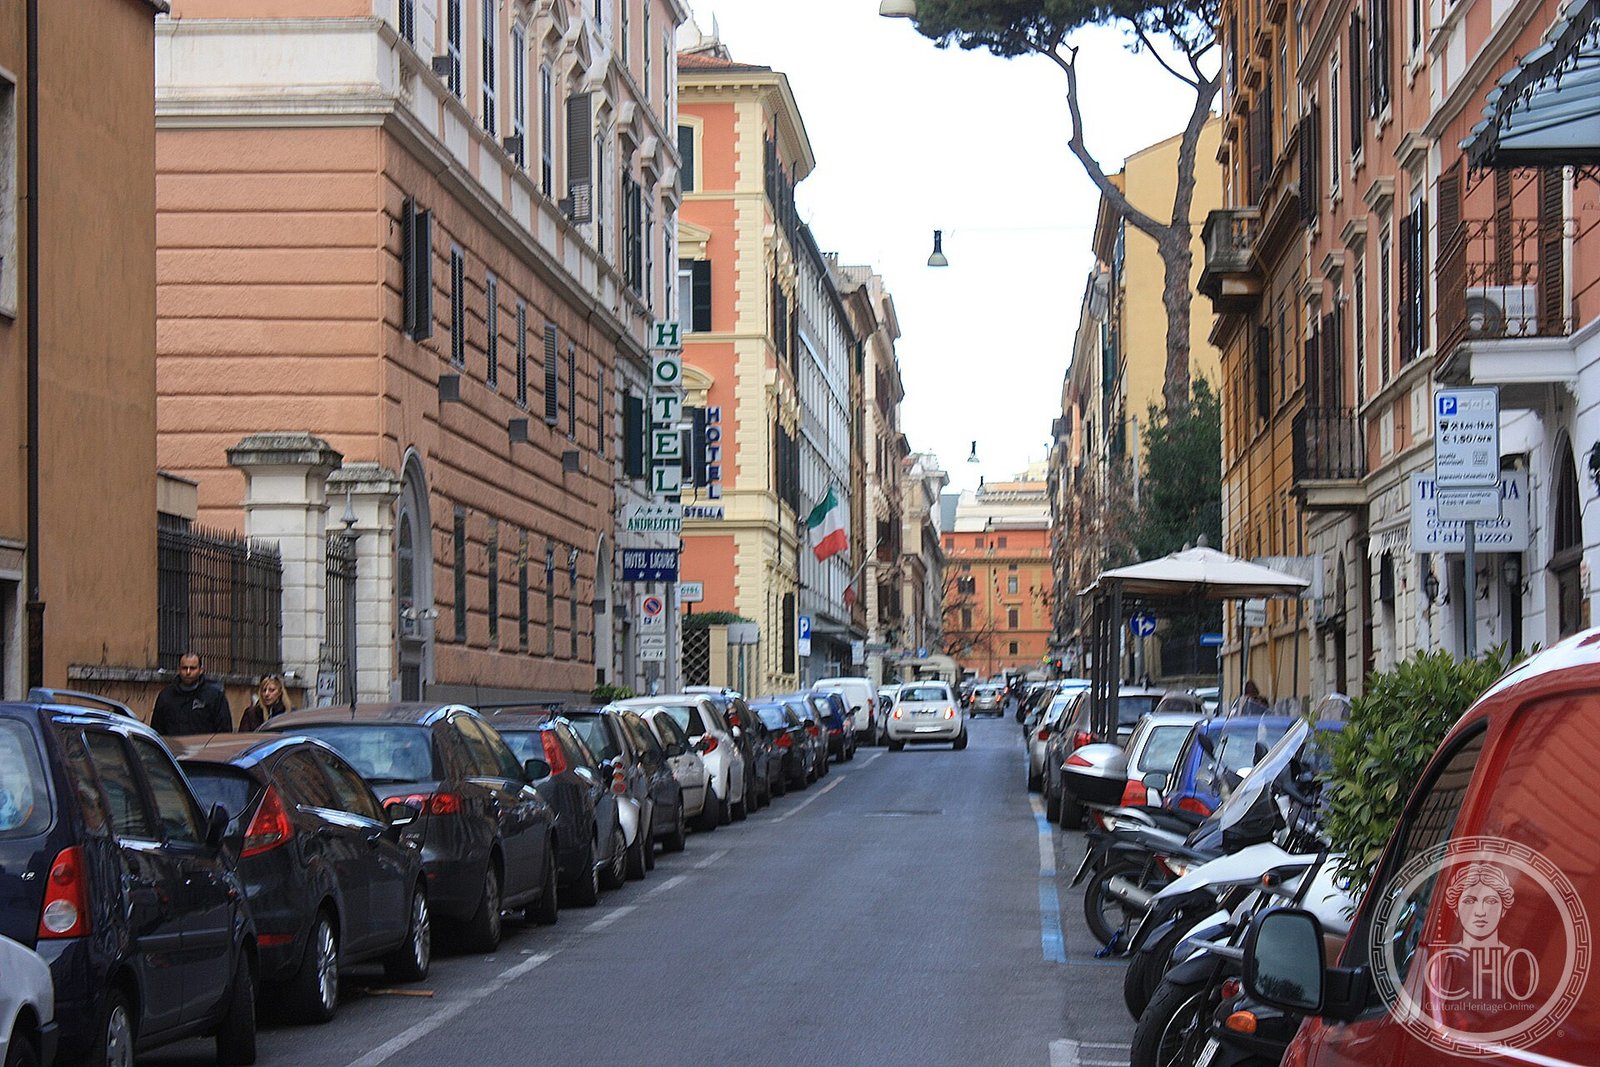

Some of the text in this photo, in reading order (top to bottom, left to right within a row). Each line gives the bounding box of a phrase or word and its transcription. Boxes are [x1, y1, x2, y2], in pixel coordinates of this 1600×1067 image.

[656, 323, 679, 492] HOTEL
[706, 407, 721, 500] HOTEL
[684, 506, 723, 518] STELLA
[624, 552, 647, 569] HOTEL
